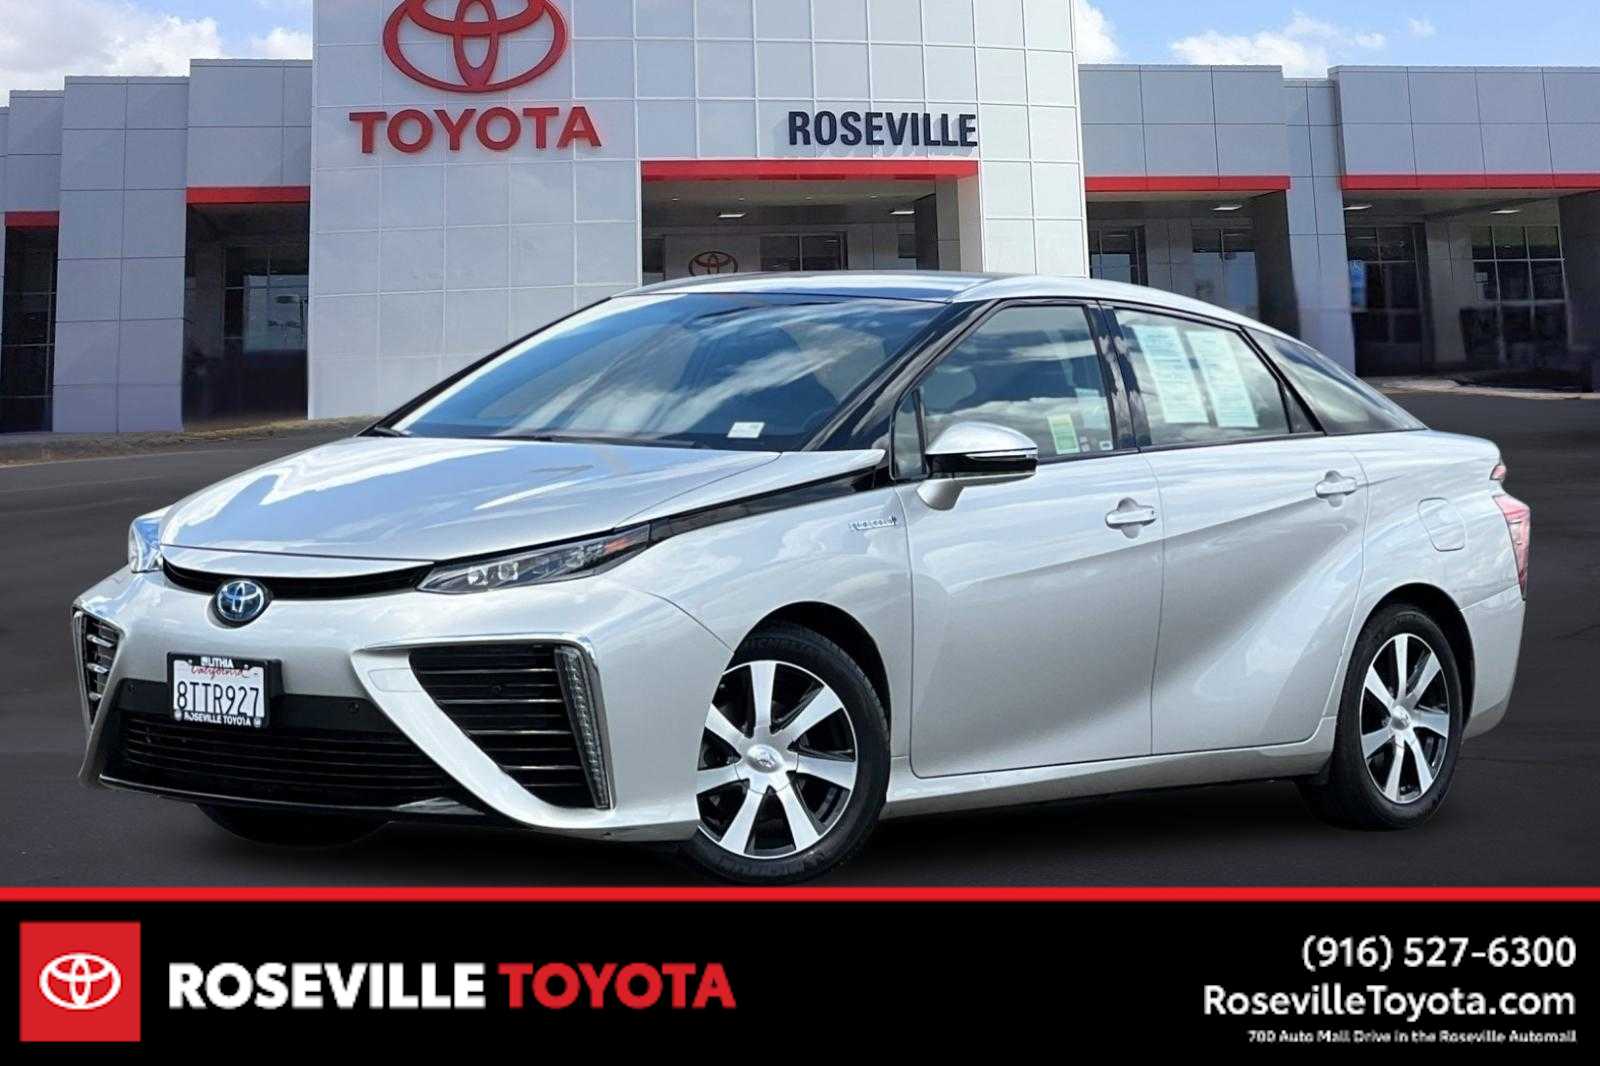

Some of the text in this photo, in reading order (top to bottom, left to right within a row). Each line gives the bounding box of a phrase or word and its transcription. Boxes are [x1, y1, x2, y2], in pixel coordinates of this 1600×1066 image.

[349, 106, 602, 154] TOYOTA
[788, 110, 978, 147] ROSEVILLE
[177, 681, 259, 717] 8TTR927
[223, 715, 251, 726] TOYOTA
